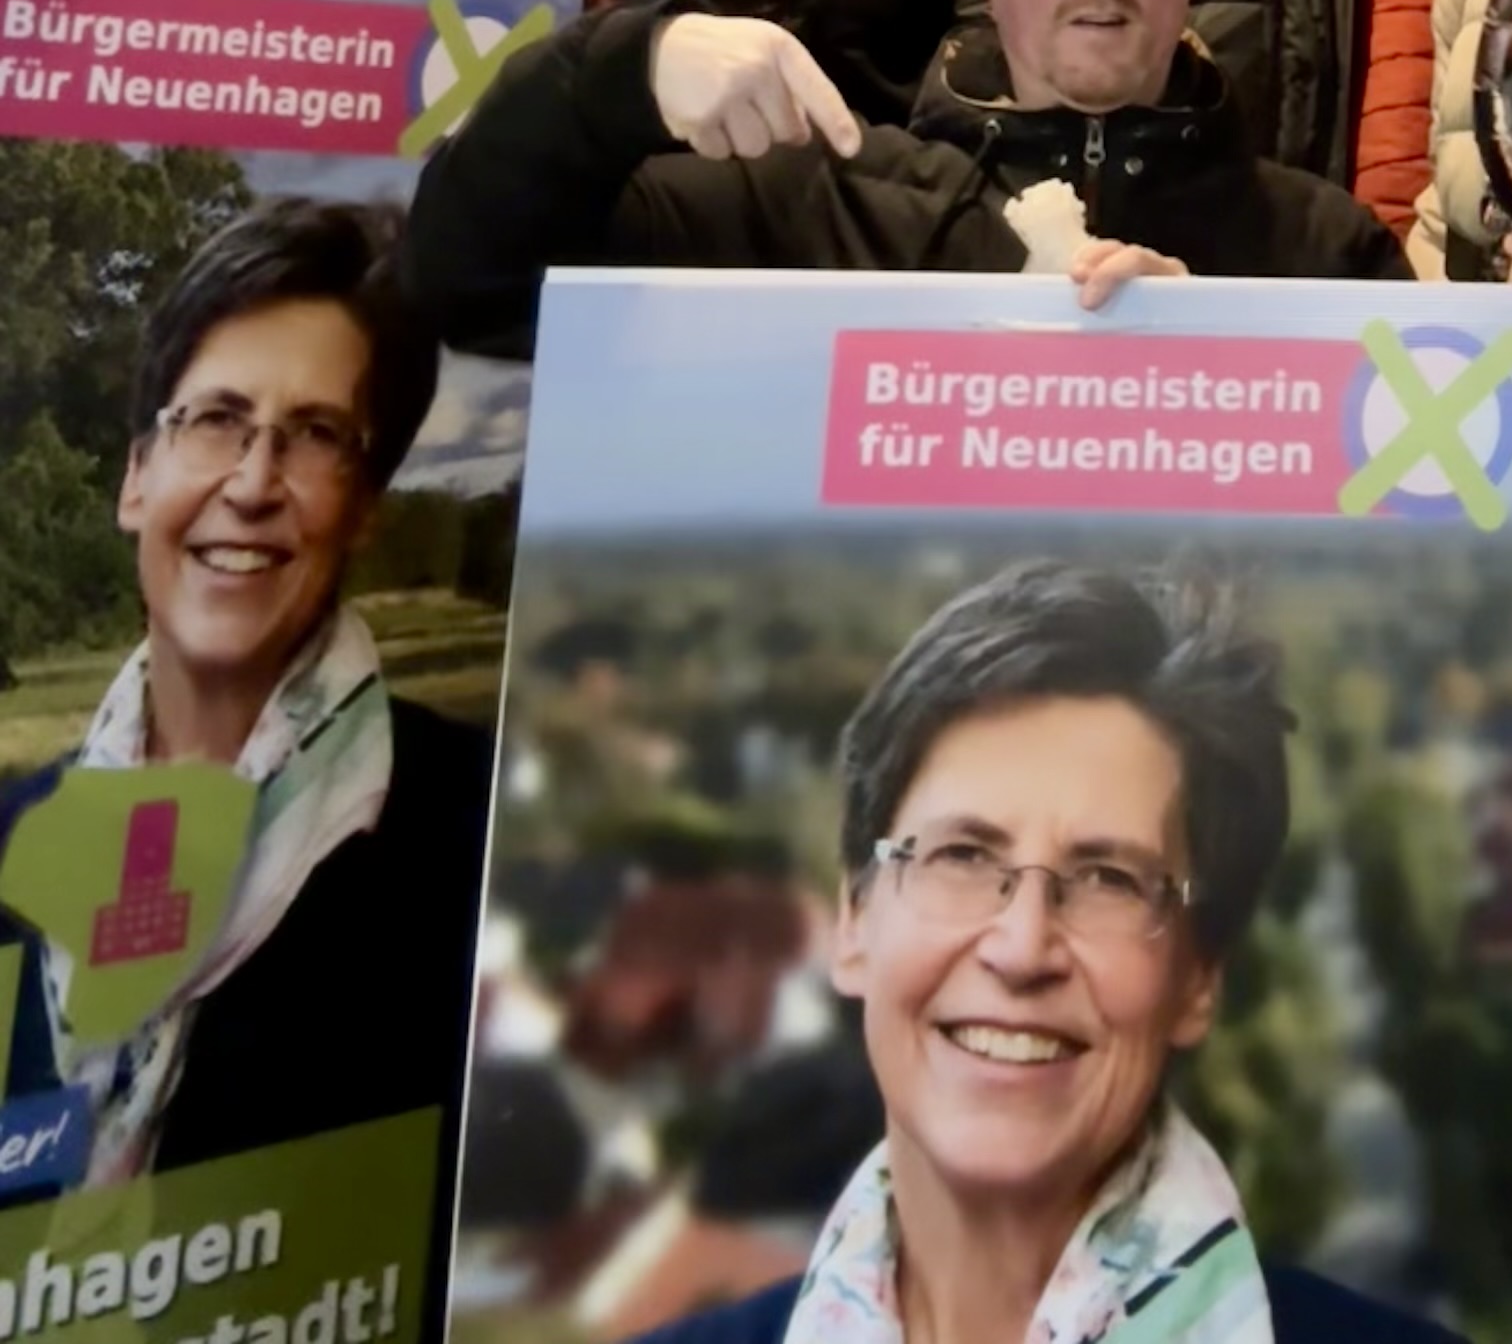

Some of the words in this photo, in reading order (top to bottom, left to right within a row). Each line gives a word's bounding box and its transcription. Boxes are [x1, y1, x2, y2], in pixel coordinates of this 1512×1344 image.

[0, 58, 71, 101] für
[86, 64, 383, 128] Neuenhagen
[864, 361, 1322, 417] Bürgermeisterin
[857, 422, 942, 467] für
[961, 426, 1313, 484] Neuenhagen
[0, 1109, 70, 1174] er!
[176, 1263, 401, 1344] tadt!
